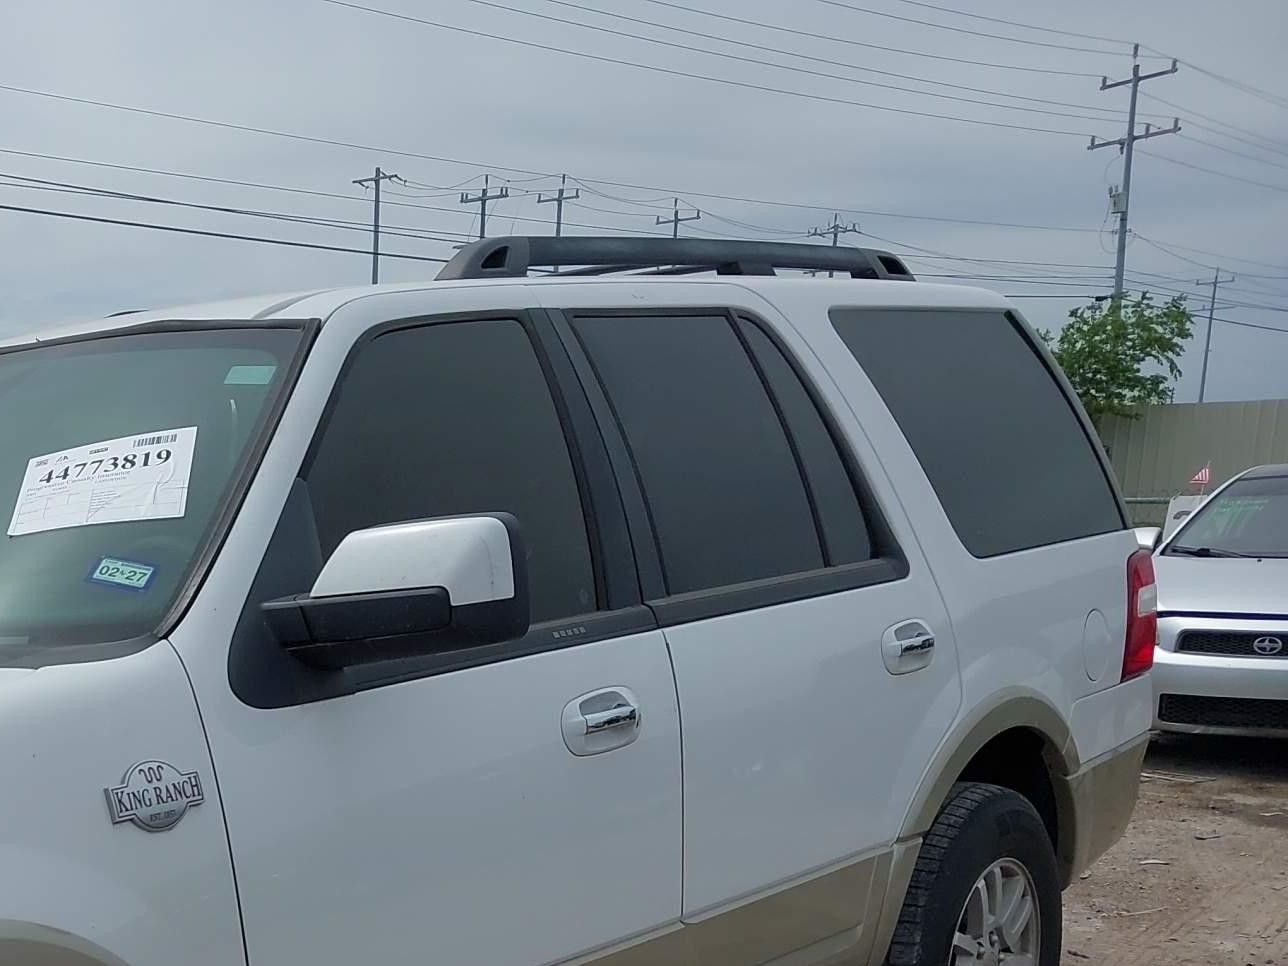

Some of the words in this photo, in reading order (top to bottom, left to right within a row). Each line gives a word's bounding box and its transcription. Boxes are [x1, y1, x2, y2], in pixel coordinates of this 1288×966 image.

[39, 449, 172, 484] 44773819
[115, 790, 152, 813] KING
[153, 775, 202, 805] RANCH
